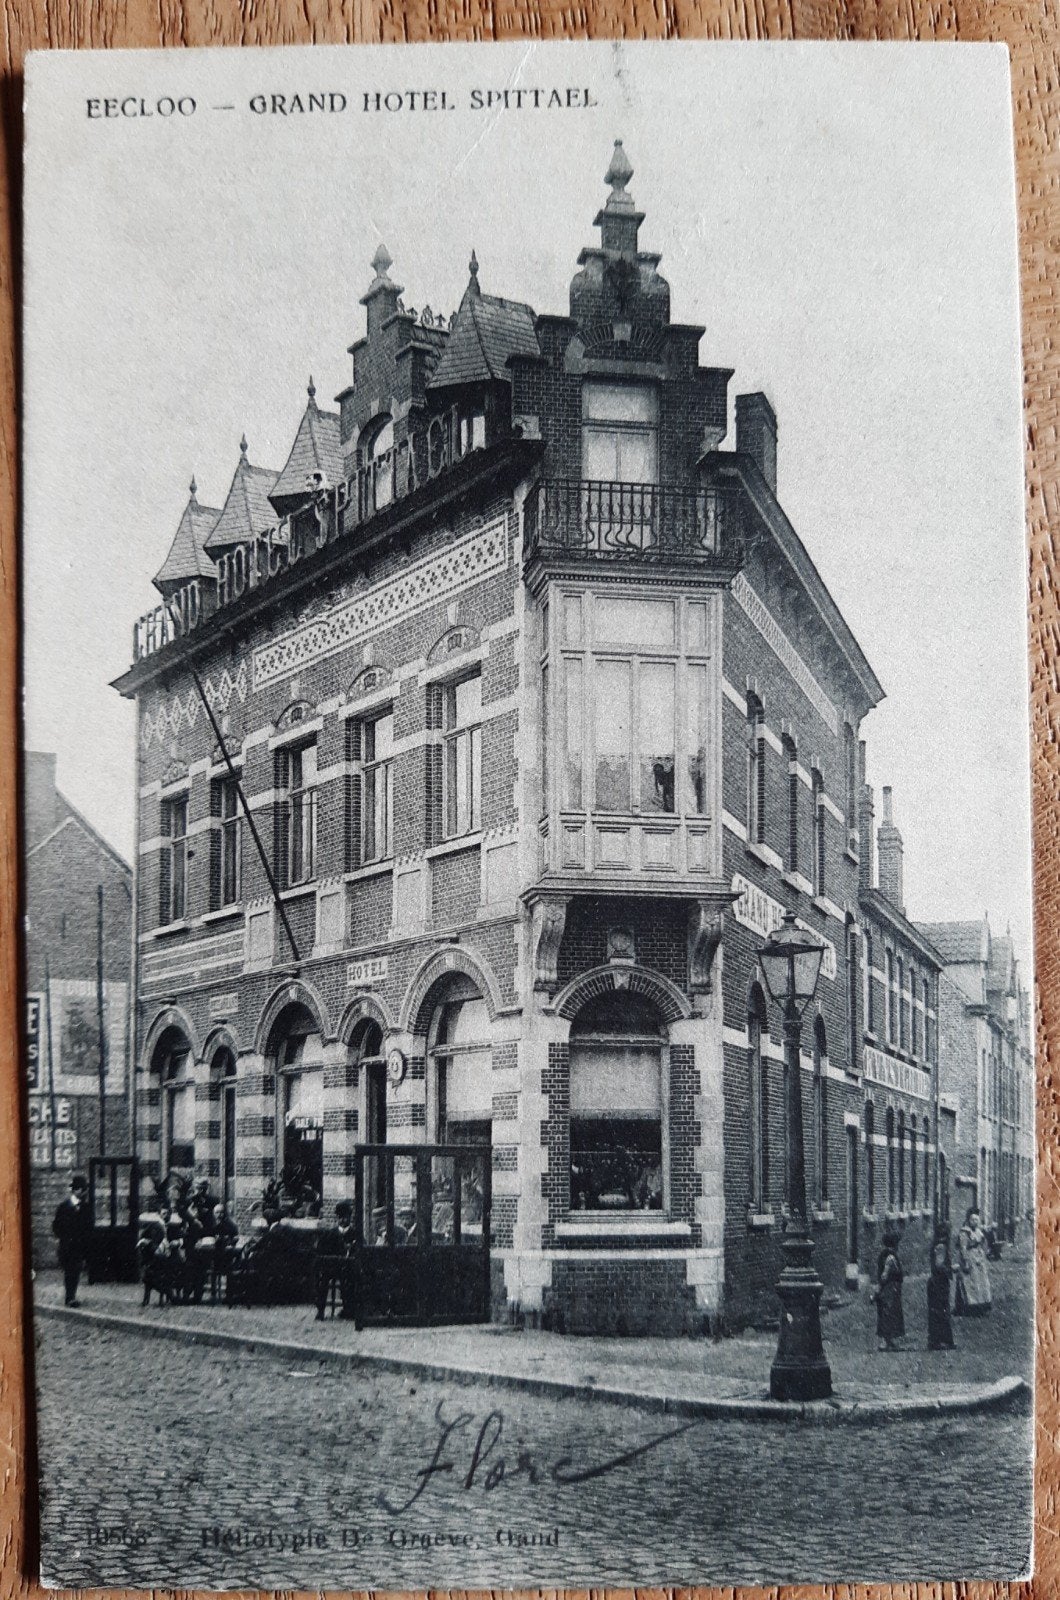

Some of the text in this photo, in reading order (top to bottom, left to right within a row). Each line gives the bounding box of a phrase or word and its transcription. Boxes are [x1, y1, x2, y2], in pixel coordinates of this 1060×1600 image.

[86, 97, 196, 118] EECLOO
[249, 94, 347, 115] GRAND
[363, 90, 455, 111] HOTEL
[470, 88, 598, 108] SPITTAEL
[133, 579, 201, 661] GRAND
[215, 507, 304, 610] HOTEL
[349, 960, 386, 981] HOTEL
[342, 1527, 374, 1548] De
